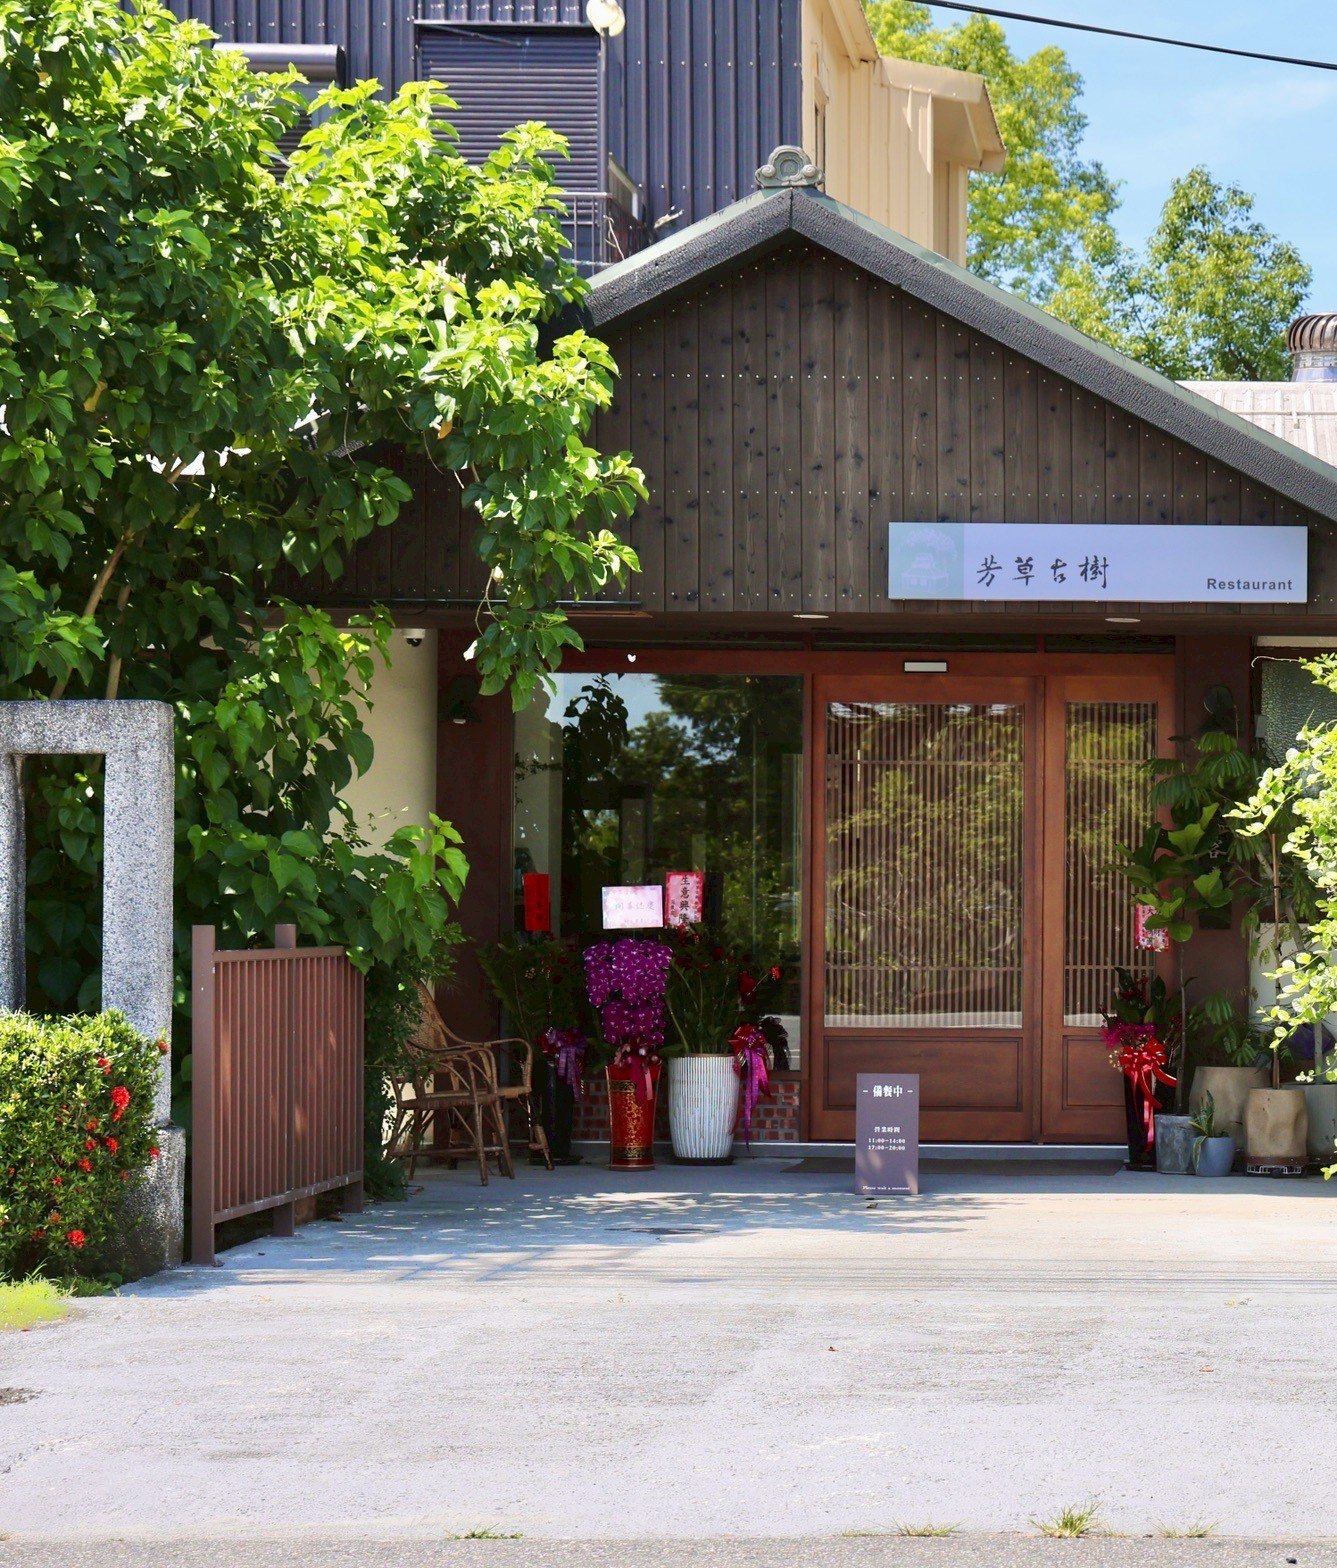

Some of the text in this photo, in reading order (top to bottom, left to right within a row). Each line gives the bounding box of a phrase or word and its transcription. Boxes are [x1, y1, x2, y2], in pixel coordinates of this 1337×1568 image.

[976, 554, 1109, 590] 芳草古樹
[1206, 577, 1293, 591] Restaurant
[679, 875, 691, 925] 生意興隆
